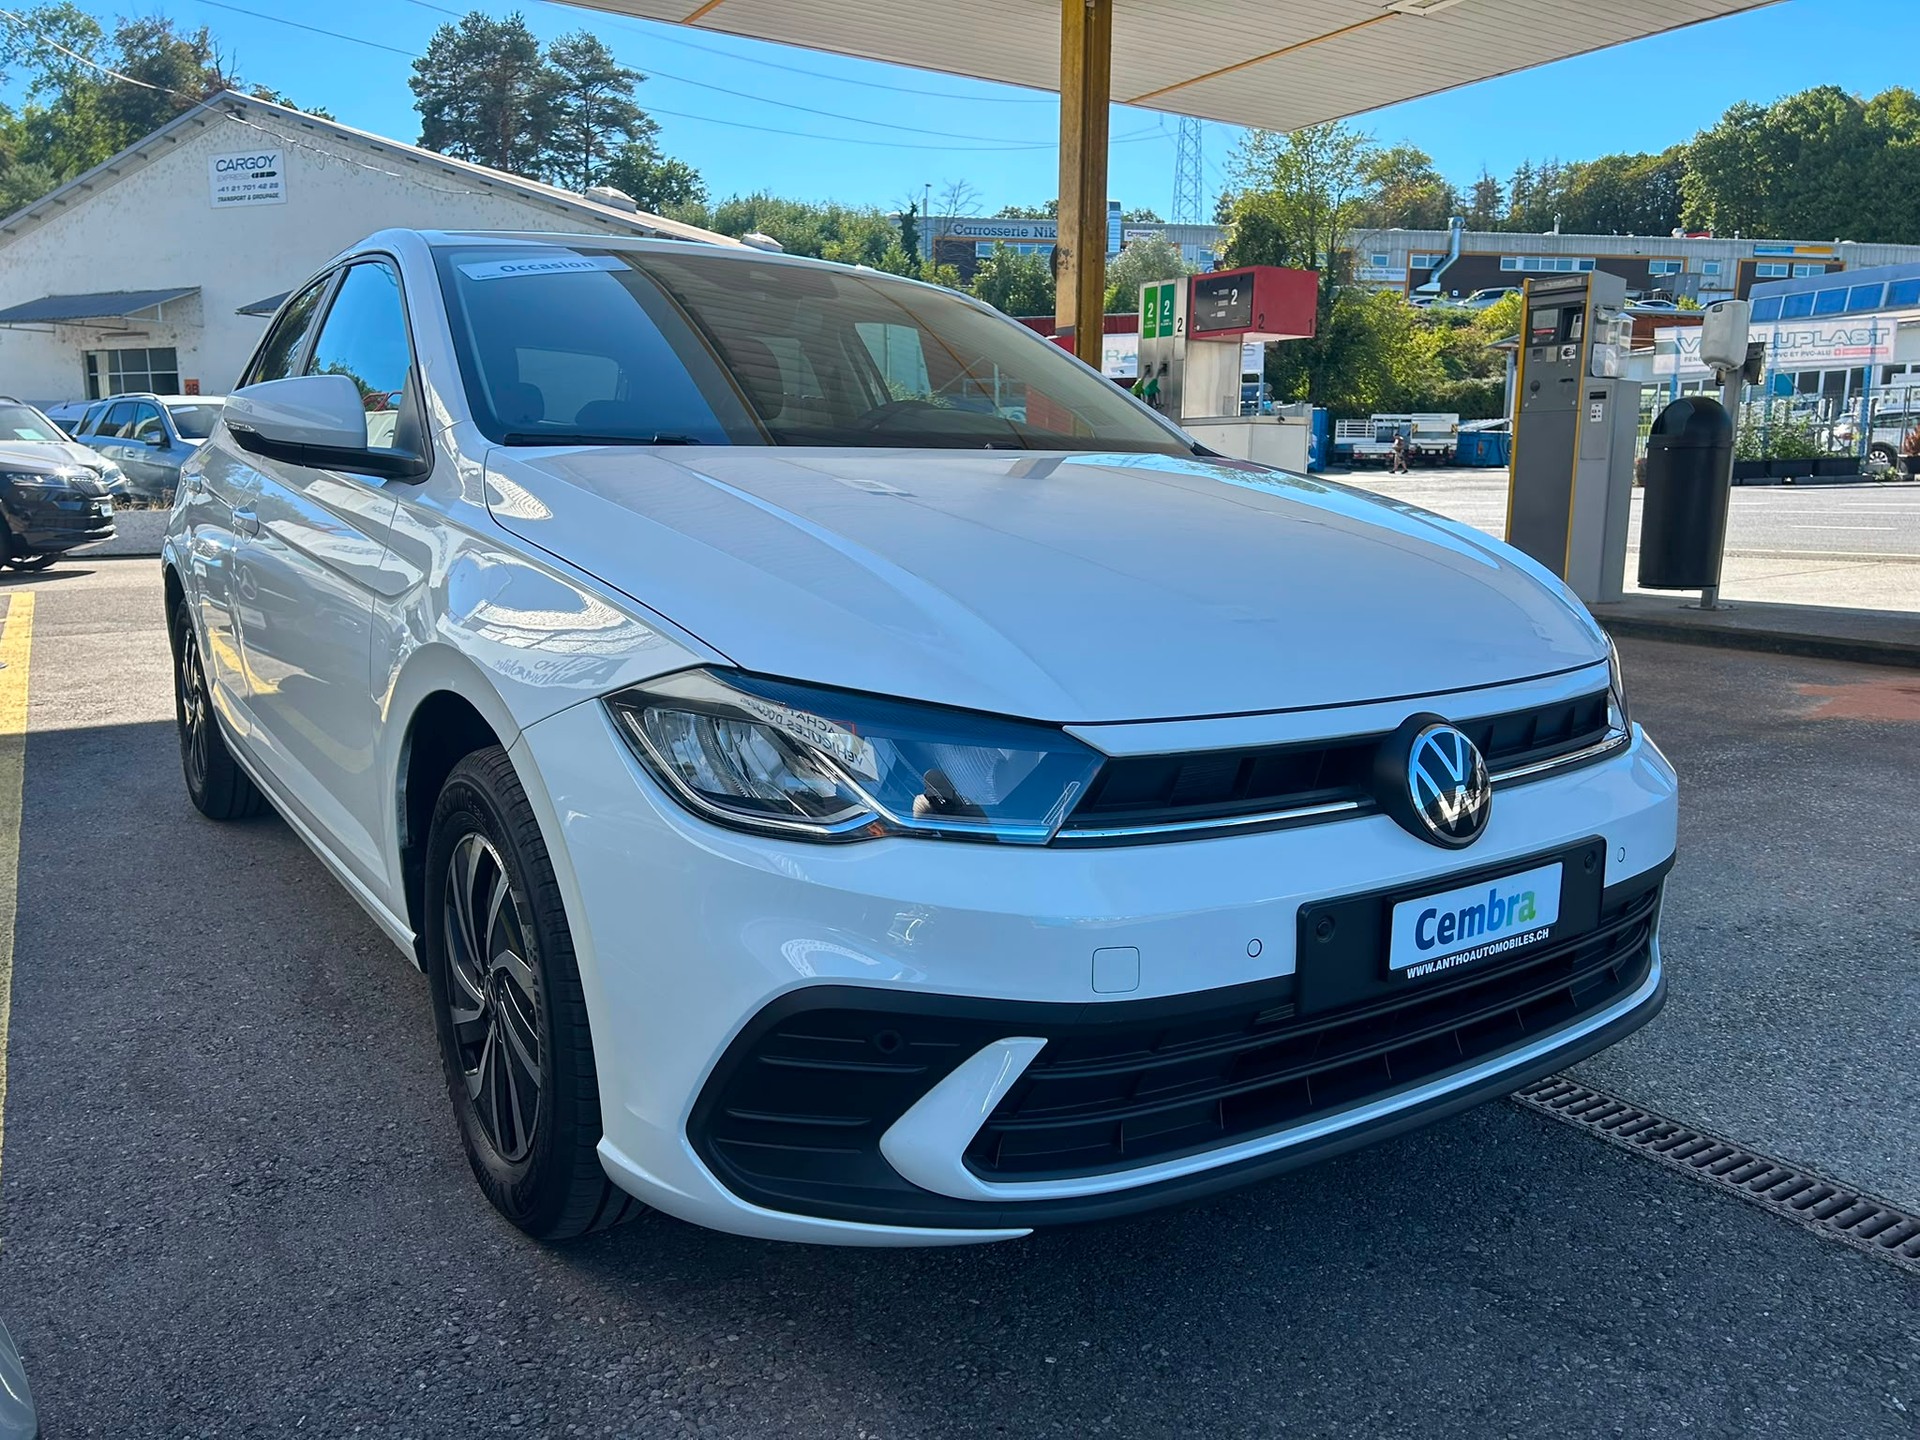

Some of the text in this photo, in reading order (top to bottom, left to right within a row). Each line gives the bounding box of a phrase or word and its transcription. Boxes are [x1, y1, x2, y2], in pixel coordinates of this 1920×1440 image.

[216, 154, 276, 172] CARGOY
[953, 224, 1029, 237] Carrosserie
[500, 260, 595, 273] Occasion
[1231, 288, 1238, 305] 2
[1148, 303, 1154, 318] 2
[1164, 300, 1170, 316] 2
[1177, 317, 1183, 333] 2
[1258, 313, 1265, 330] 2
[1308, 318, 1313, 334] 1
[1414, 888, 1536, 950] Cembra
[1406, 928, 1550, 979] WWW.ANTHOAUTOMOBILES.CH
